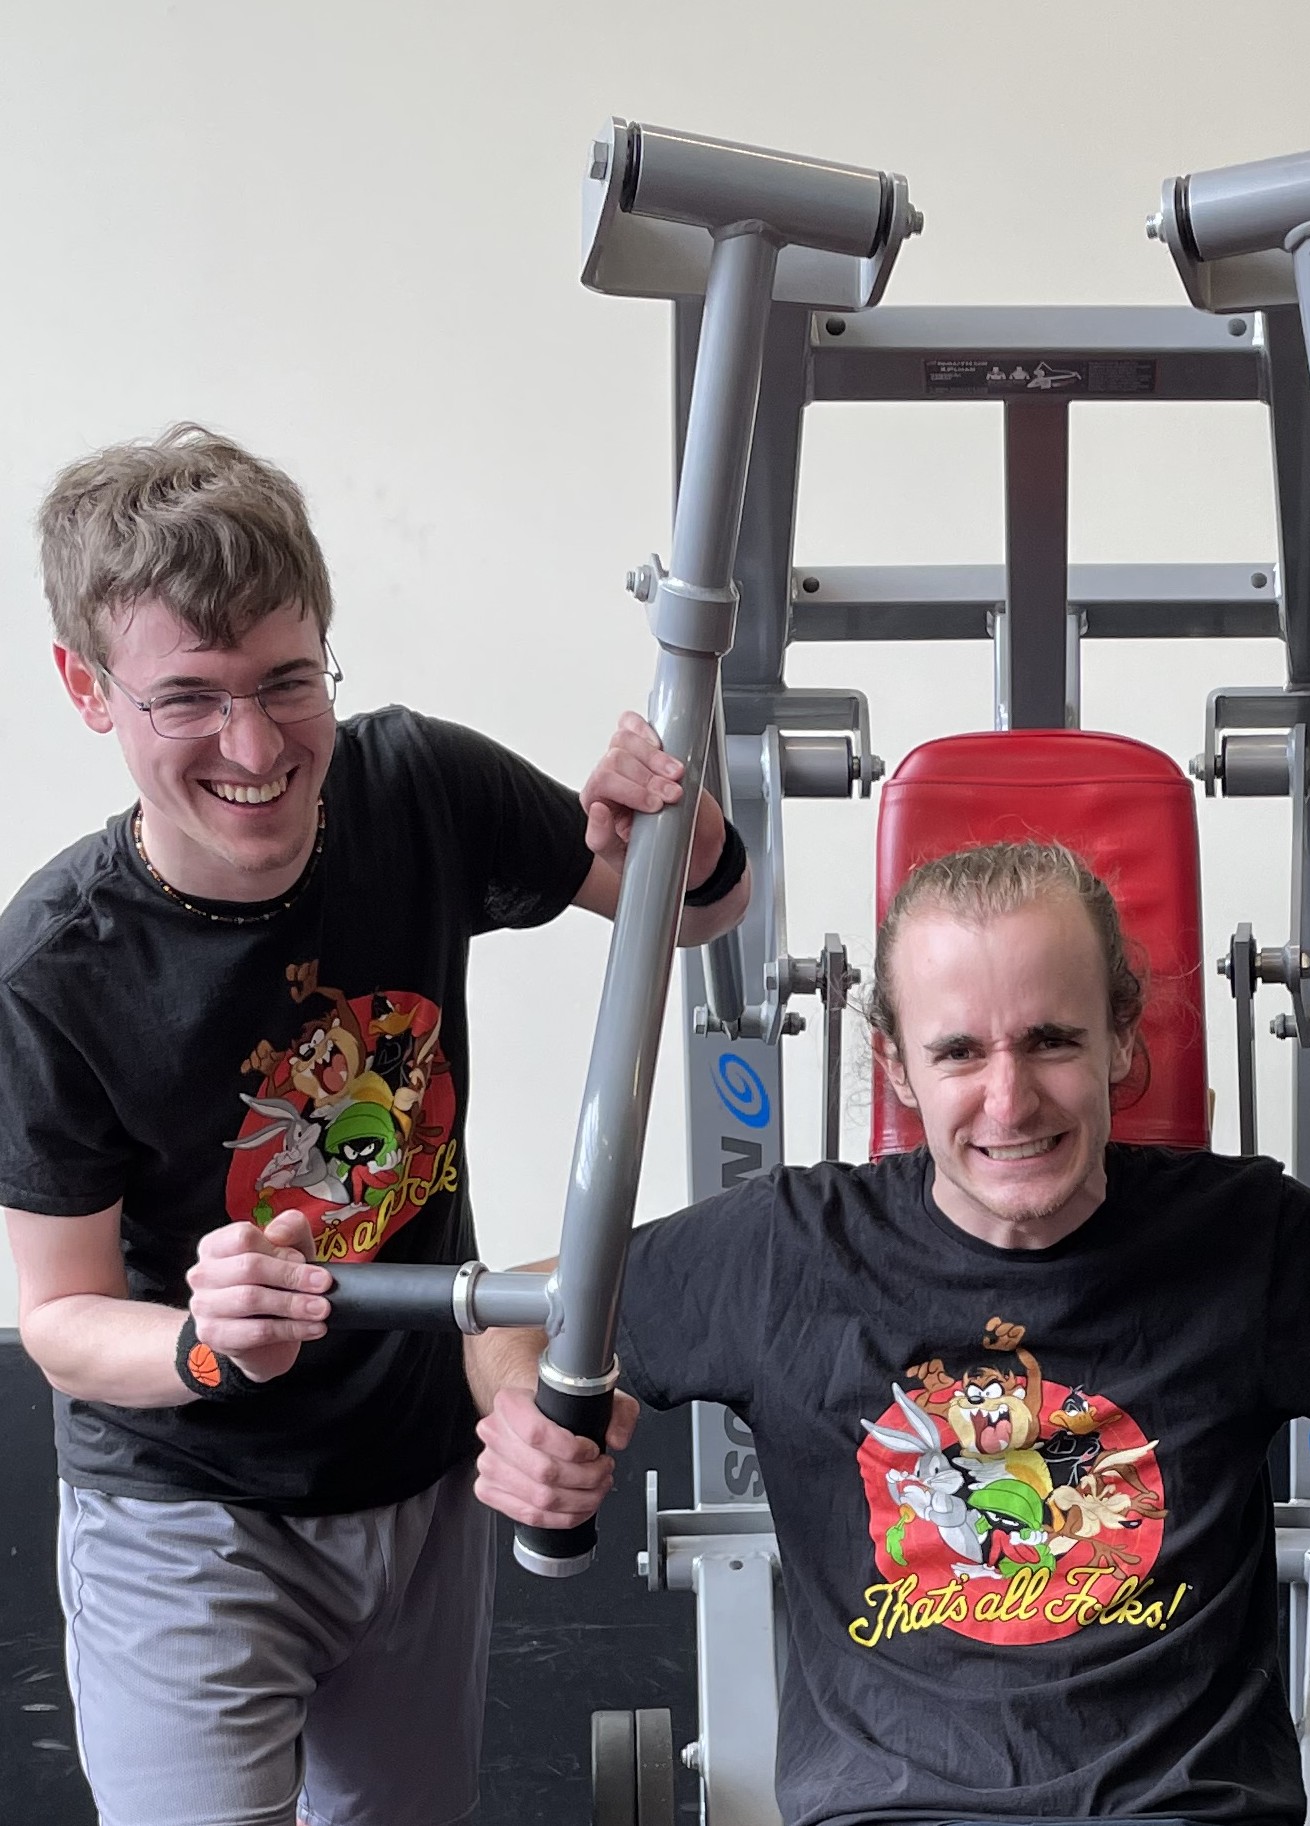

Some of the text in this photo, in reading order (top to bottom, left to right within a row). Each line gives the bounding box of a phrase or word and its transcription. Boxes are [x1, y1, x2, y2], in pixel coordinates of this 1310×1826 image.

[353, 1190, 395, 1252] al
[390, 1138, 458, 1216] Folk
[848, 1566, 1187, 1647] That's all Folks!
